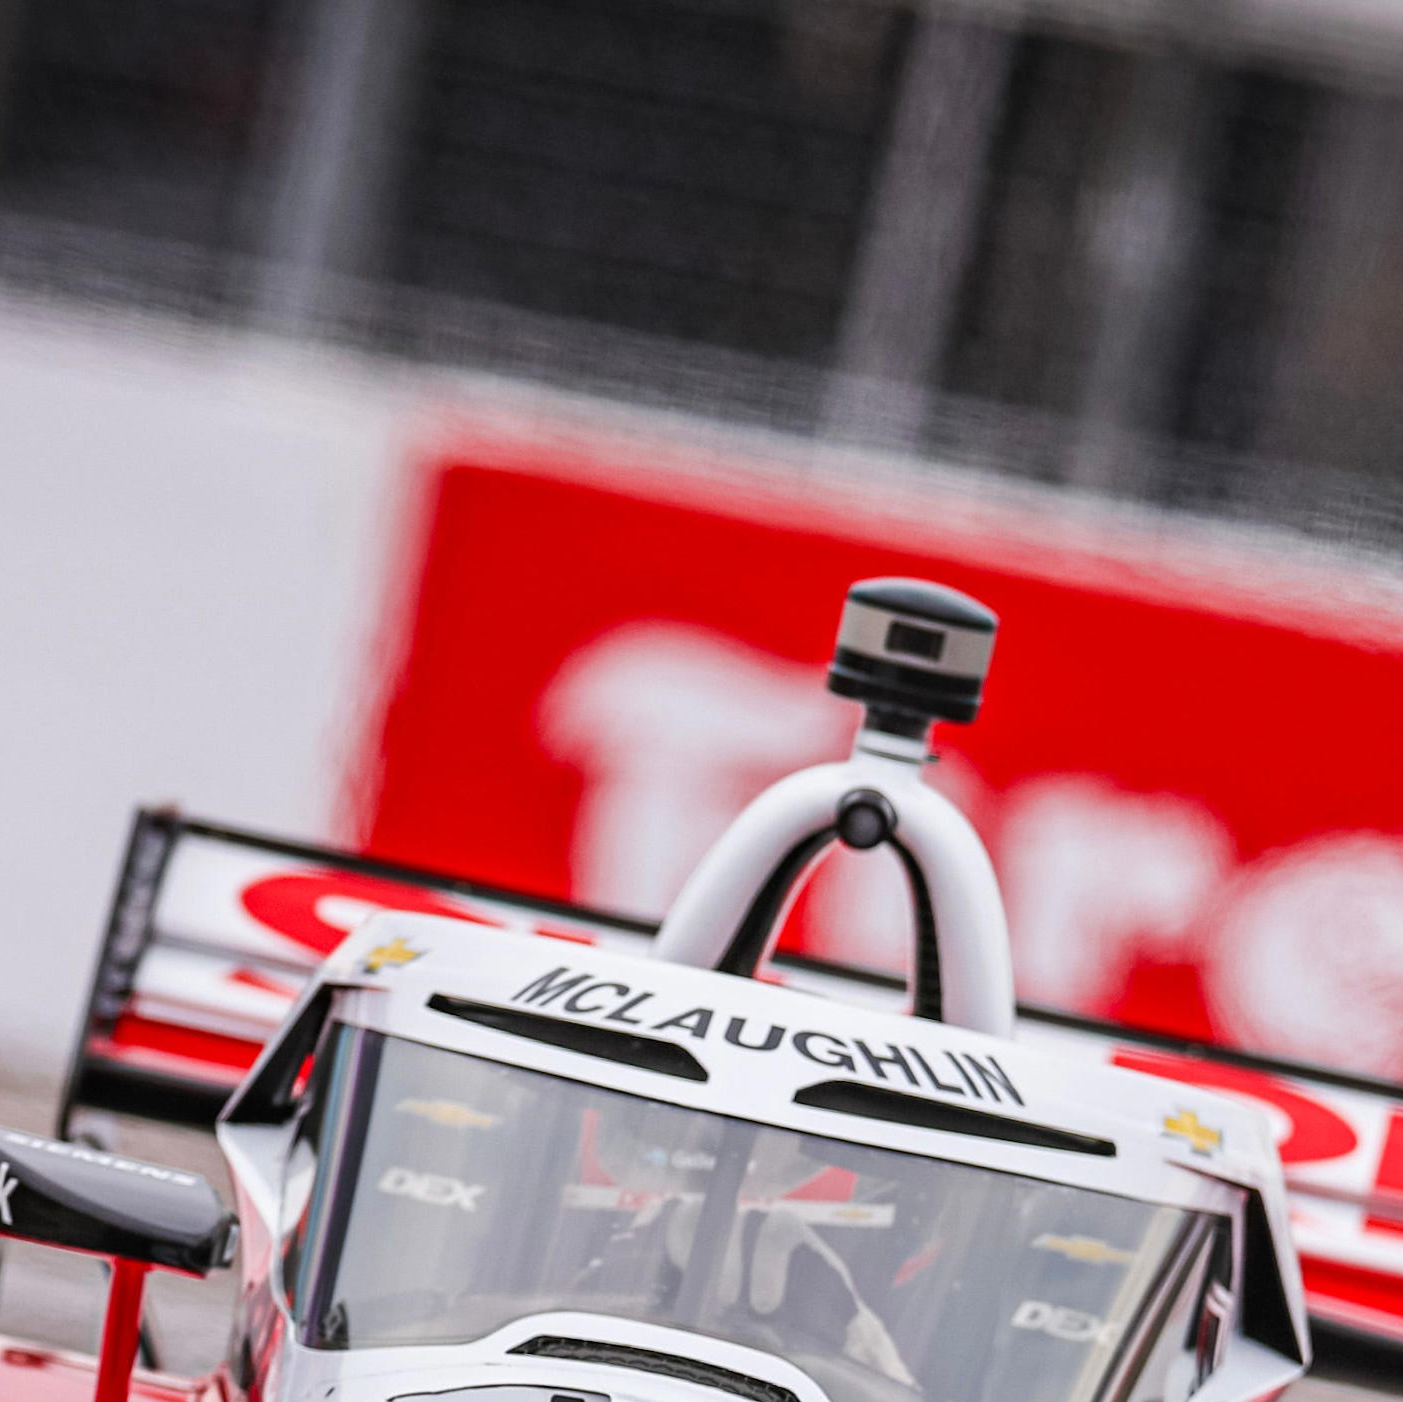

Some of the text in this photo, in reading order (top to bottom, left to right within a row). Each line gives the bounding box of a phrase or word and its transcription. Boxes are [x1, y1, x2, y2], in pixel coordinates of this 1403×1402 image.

[510, 966, 1027, 1107] MCLAUGHLIN
[4, 1132, 197, 1187] SIEMENS
[378, 1166, 488, 1212] DEX
